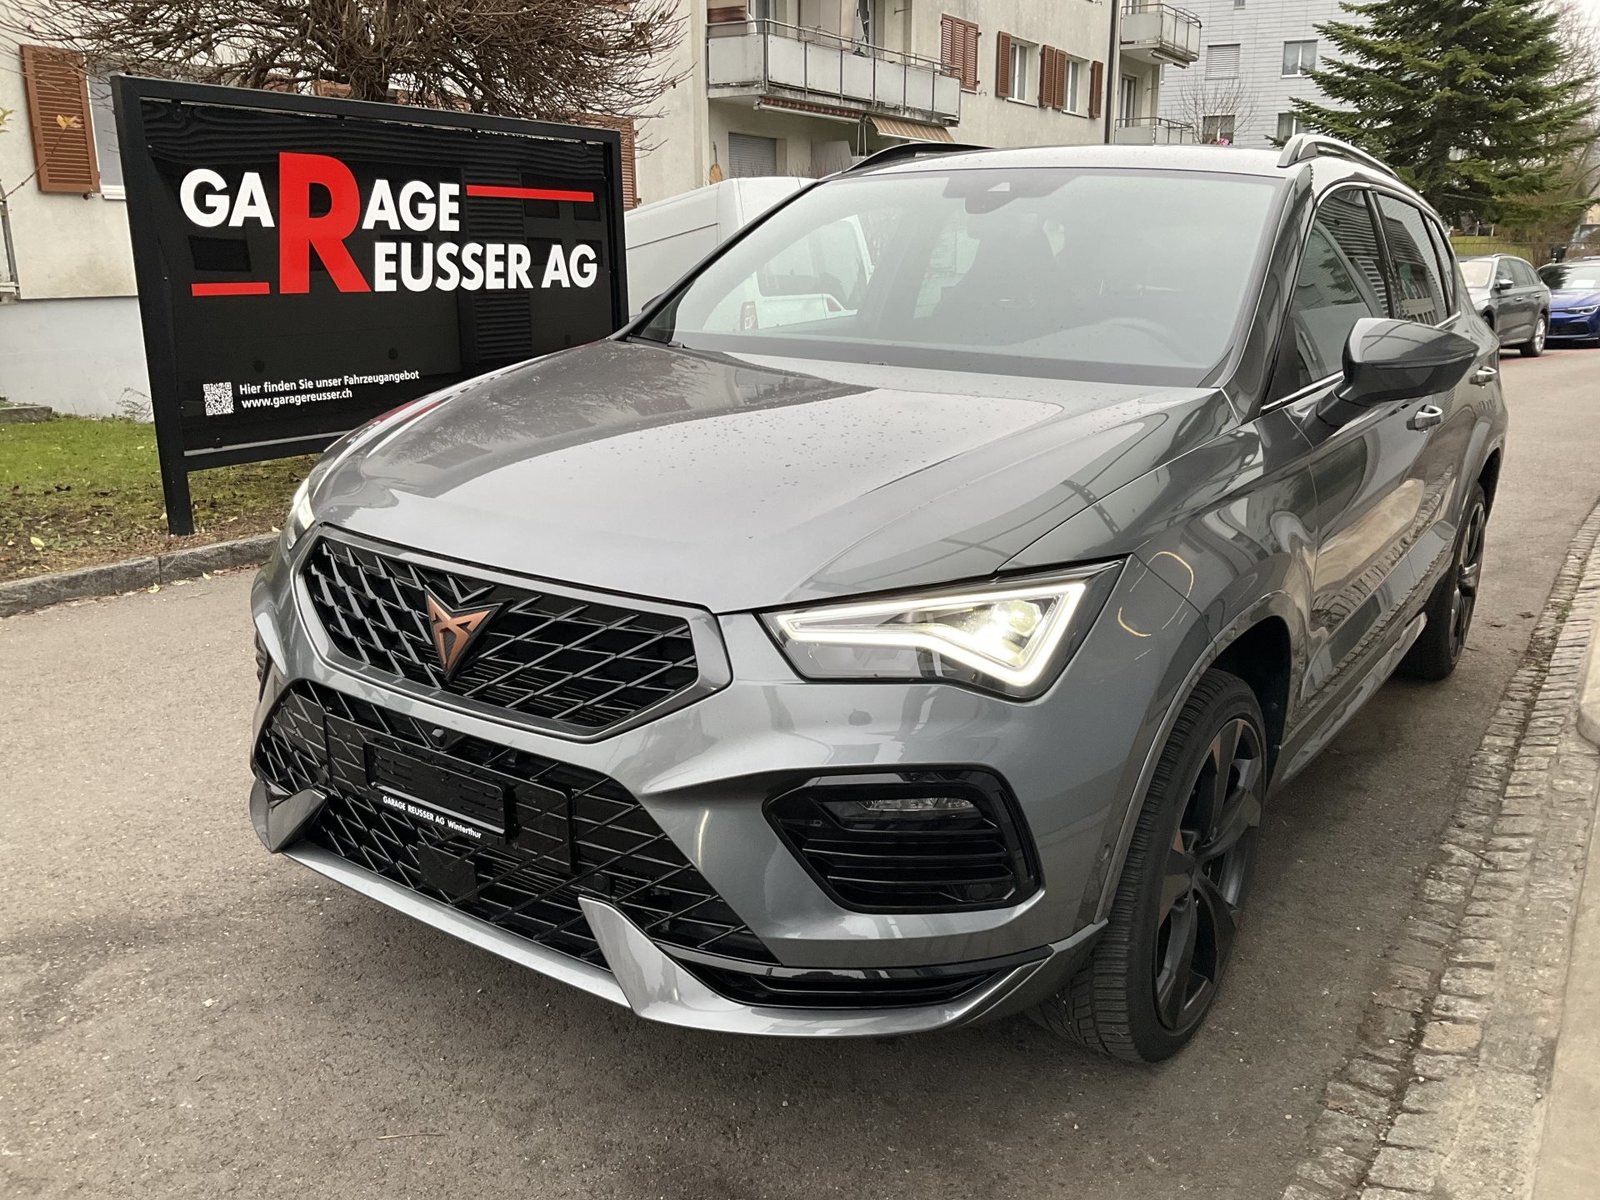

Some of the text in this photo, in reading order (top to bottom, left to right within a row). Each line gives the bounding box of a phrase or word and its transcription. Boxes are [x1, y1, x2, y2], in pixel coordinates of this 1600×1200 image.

[179, 151, 460, 294] GARAGE
[540, 243, 598, 290] AG
[239, 370, 420, 395] Hier finden Sie unser Fahrzeugangebot
[241, 389, 353, 409] www.garagereusser.ch
[383, 795, 482, 839] GARAGE REUSSER AG Winterthur
